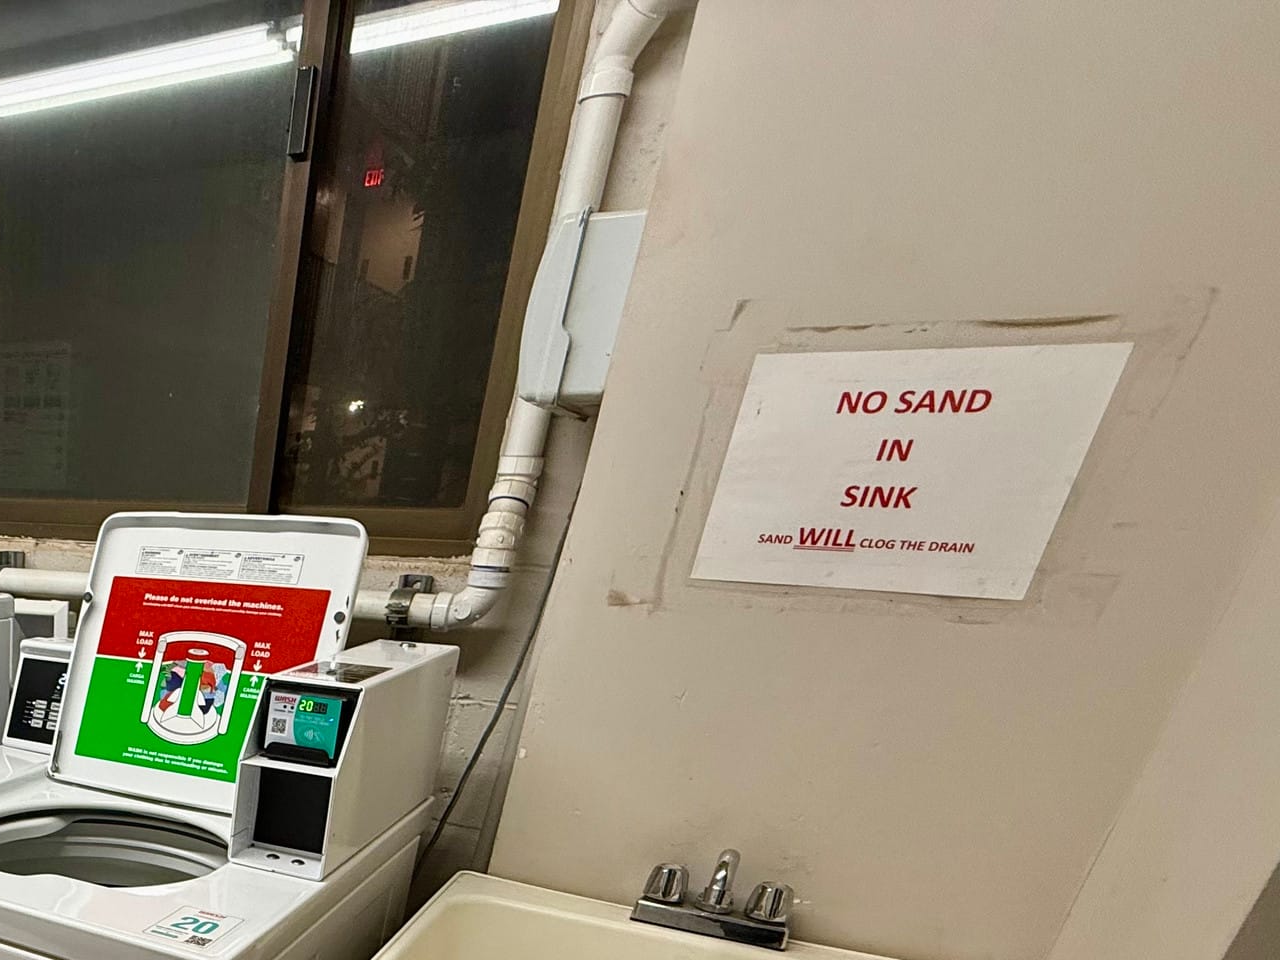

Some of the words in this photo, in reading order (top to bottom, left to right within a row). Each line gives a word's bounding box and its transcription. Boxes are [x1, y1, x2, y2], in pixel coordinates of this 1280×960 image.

[836, 391, 888, 414] NO
[894, 389, 992, 413] SAND
[876, 439, 913, 461] IN
[840, 485, 917, 508] SINK
[758, 533, 793, 545] SAND
[797, 527, 856, 549] WILL
[859, 537, 896, 550] CLOG
[899, 540, 926, 552] THE
[928, 541, 975, 554] DRAIN
[144, 593, 169, 602] Please
[169, 595, 179, 603] do
[180, 596, 193, 604] not
[194, 597, 228, 607] overload
[228, 599, 242, 608] the
[243, 601, 284, 611] machines.
[139, 630, 154, 638] MAX
[136, 638, 154, 646] LOAD
[254, 641, 271, 649] MAX
[251, 650, 271, 658] LOAD
[274, 695, 297, 704] WASH
[299, 699, 314, 712] 20
[170, 916, 220, 935] 20
